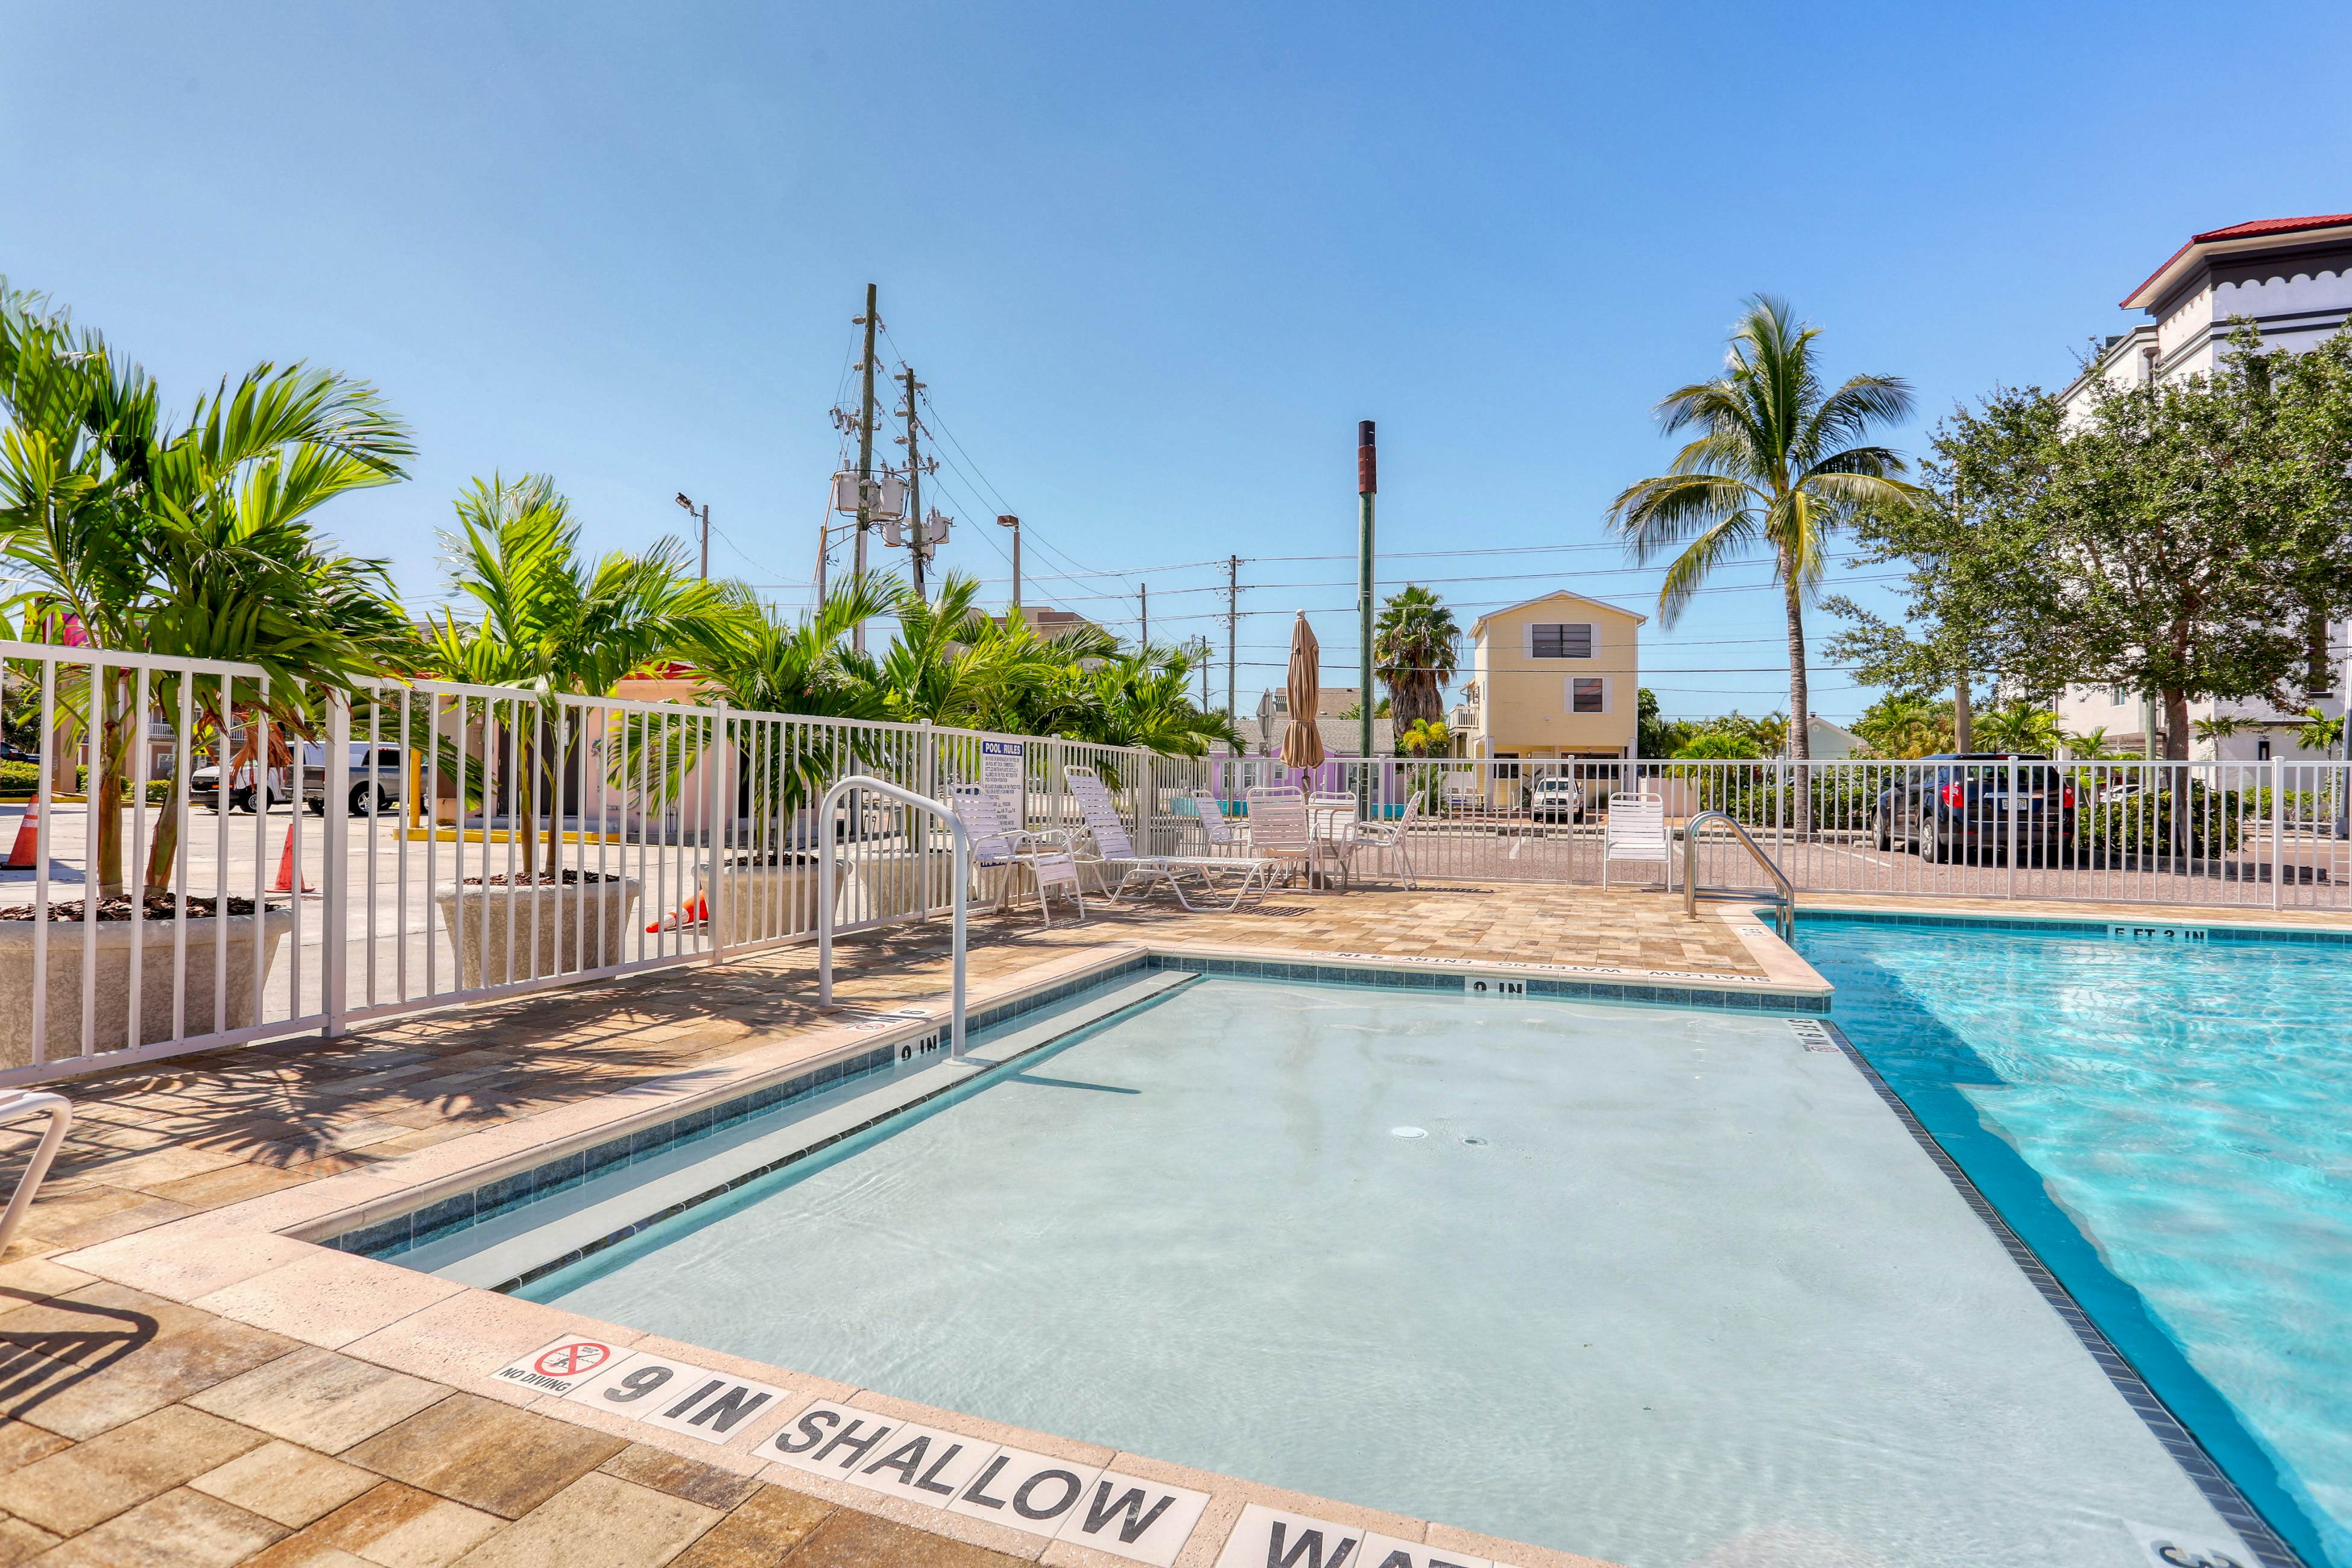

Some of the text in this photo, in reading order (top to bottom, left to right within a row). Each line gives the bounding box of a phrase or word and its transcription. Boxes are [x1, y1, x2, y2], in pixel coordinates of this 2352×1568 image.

[985, 742, 1020, 754] POOL RULES
[2185, 931, 2204, 939] IN
[1649, 971, 1772, 982] SHALLOW
[1499, 982, 1523, 994] IN
[920, 1034, 937, 1055] IN
[499, 1367, 572, 1391] NO DIVING
[603, 1366, 773, 1433] 9 IN
[774, 1410, 1177, 1544] SHALLOW
